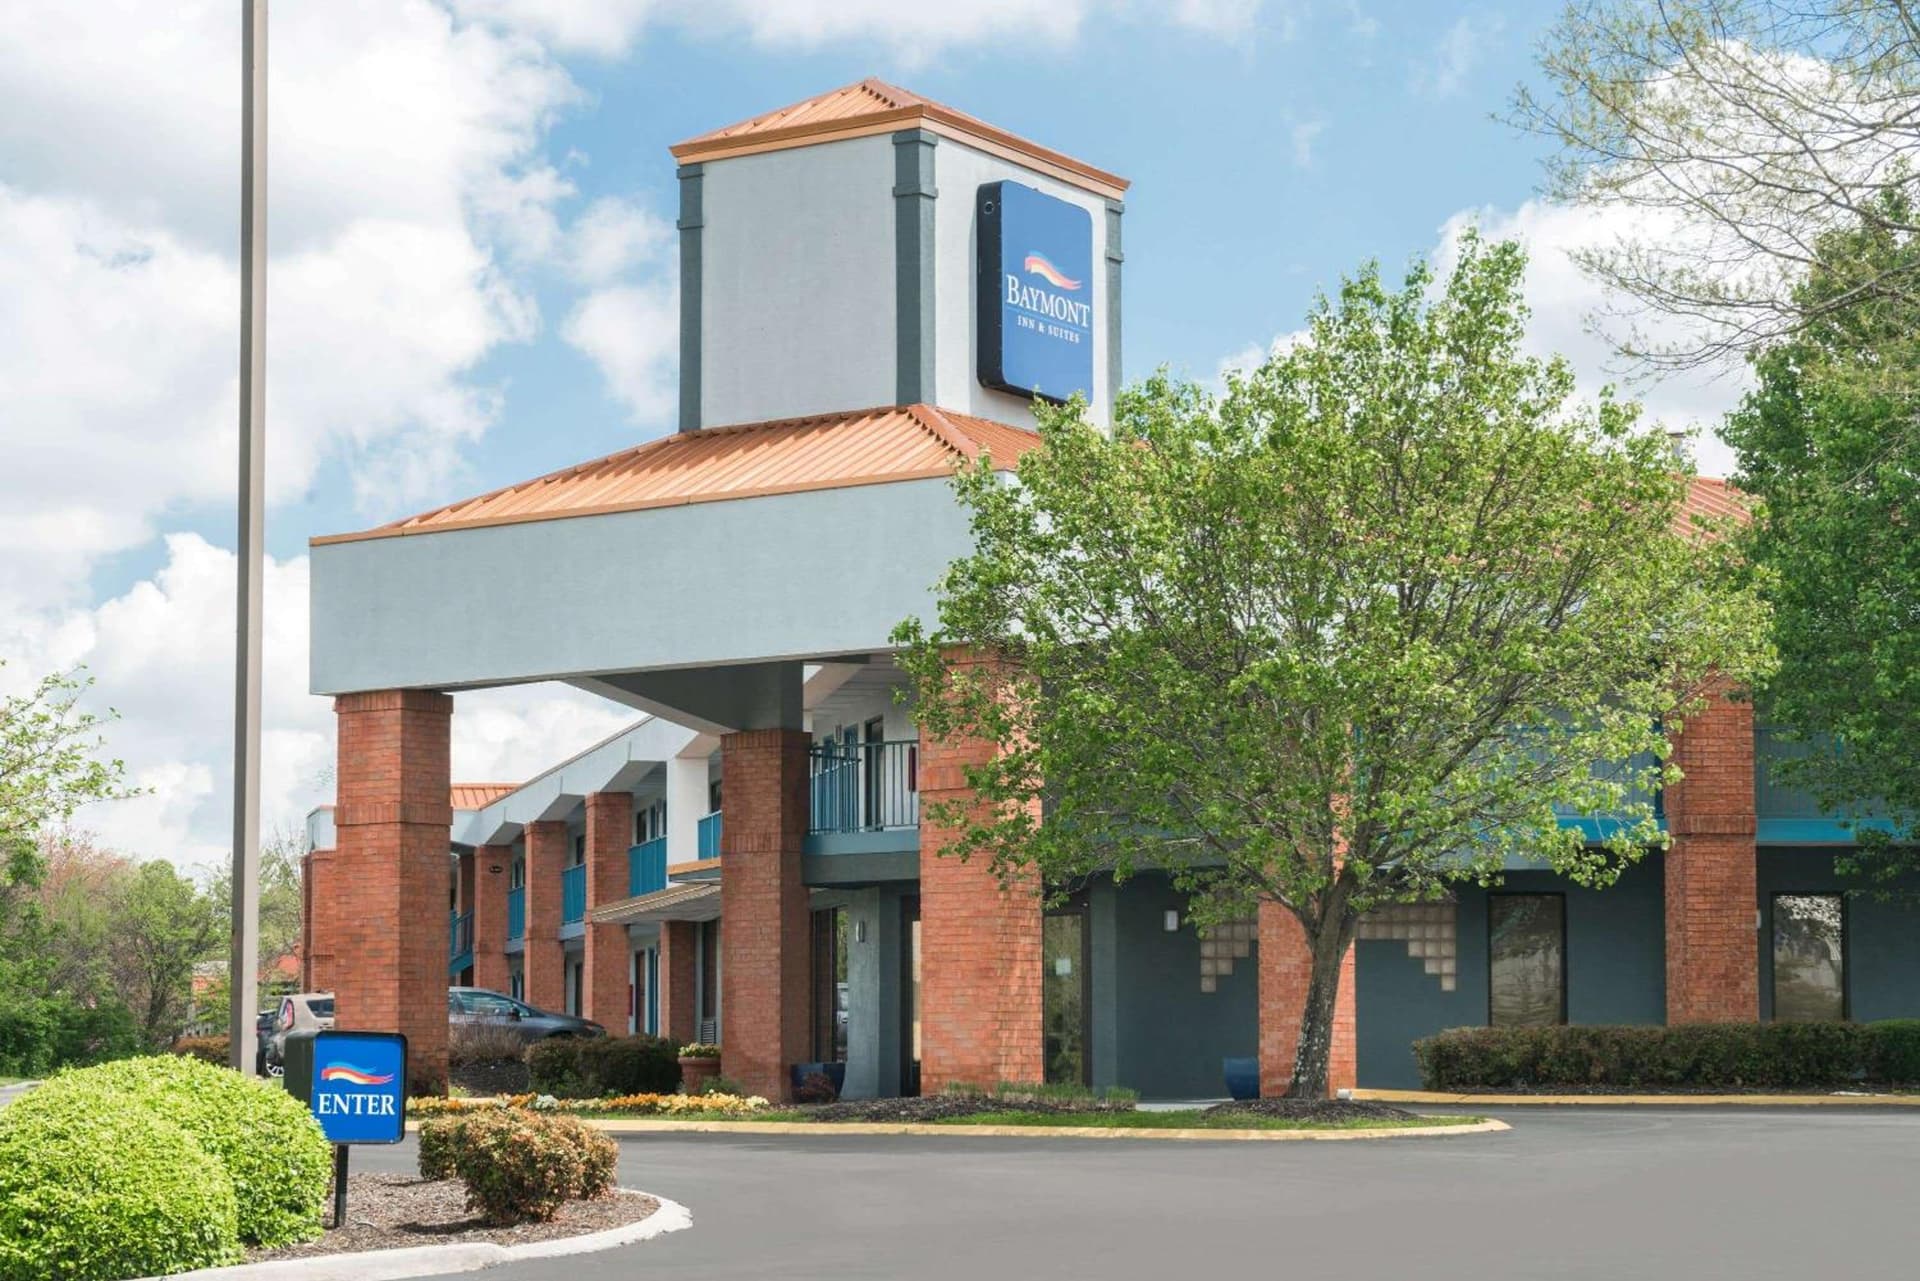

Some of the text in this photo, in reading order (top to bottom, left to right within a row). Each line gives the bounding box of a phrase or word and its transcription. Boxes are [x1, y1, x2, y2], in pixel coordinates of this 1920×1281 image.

[1006, 274, 1090, 328] BAYMONT
[1017, 315, 1080, 344] INN & SUITES
[318, 1093, 396, 1116] ENTER
